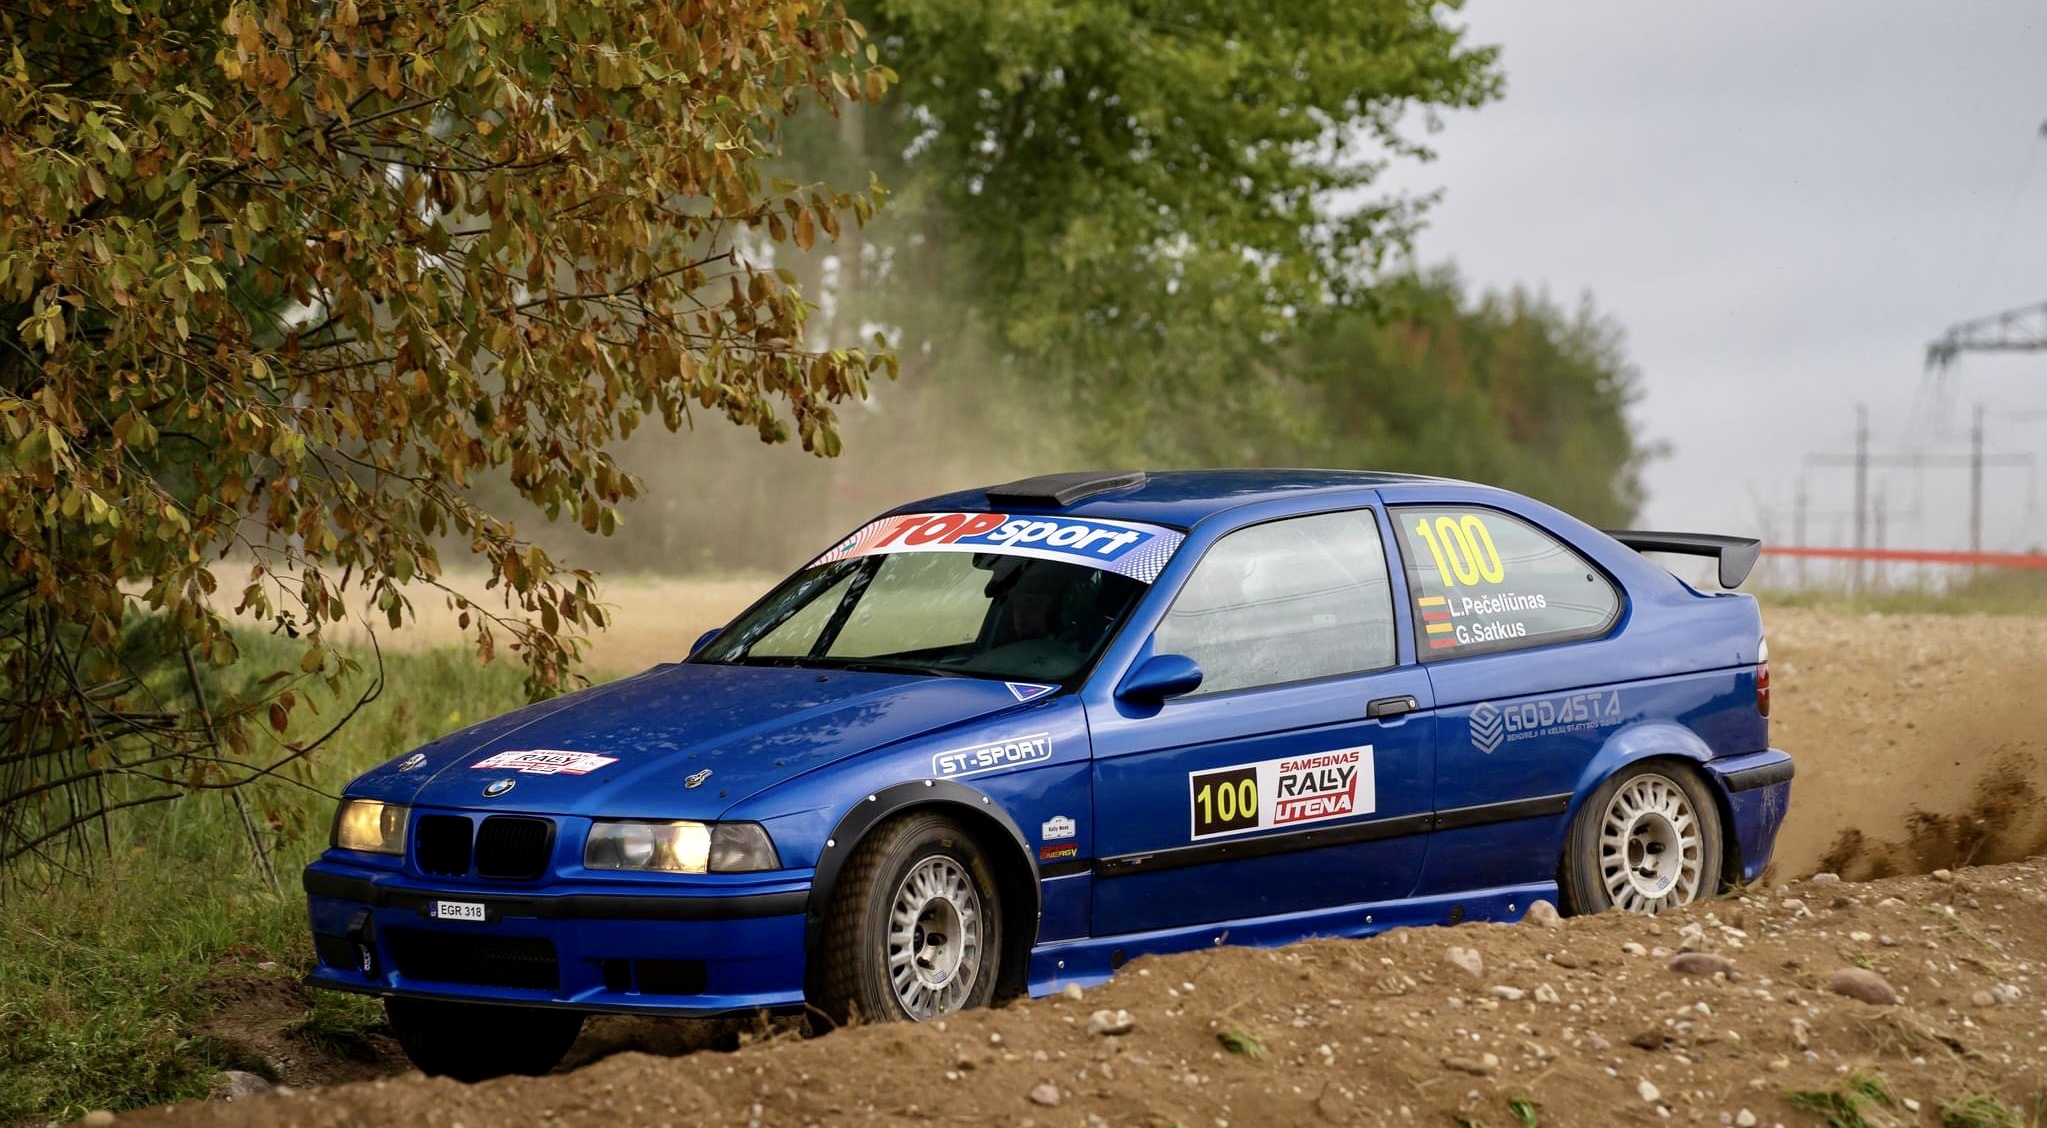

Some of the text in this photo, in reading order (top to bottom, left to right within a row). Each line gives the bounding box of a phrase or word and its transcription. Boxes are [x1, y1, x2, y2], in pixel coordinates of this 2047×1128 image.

[1415, 515, 1505, 587] 100
[1448, 593, 1547, 617] L.Pečeliūnas
[1456, 621, 1527, 644] G.Satkus
[1504, 690, 1621, 731] GODASTA
[514, 754, 580, 764] RALLY
[940, 739, 1045, 774] ST-SPORT
[1280, 751, 1359, 773] SAMSONAS
[1277, 765, 1355, 798] RALLY
[1197, 778, 1258, 824] 100
[1276, 794, 1352, 820] UTENA
[441, 904, 462, 916] EGR
[464, 906, 482, 917] 318
